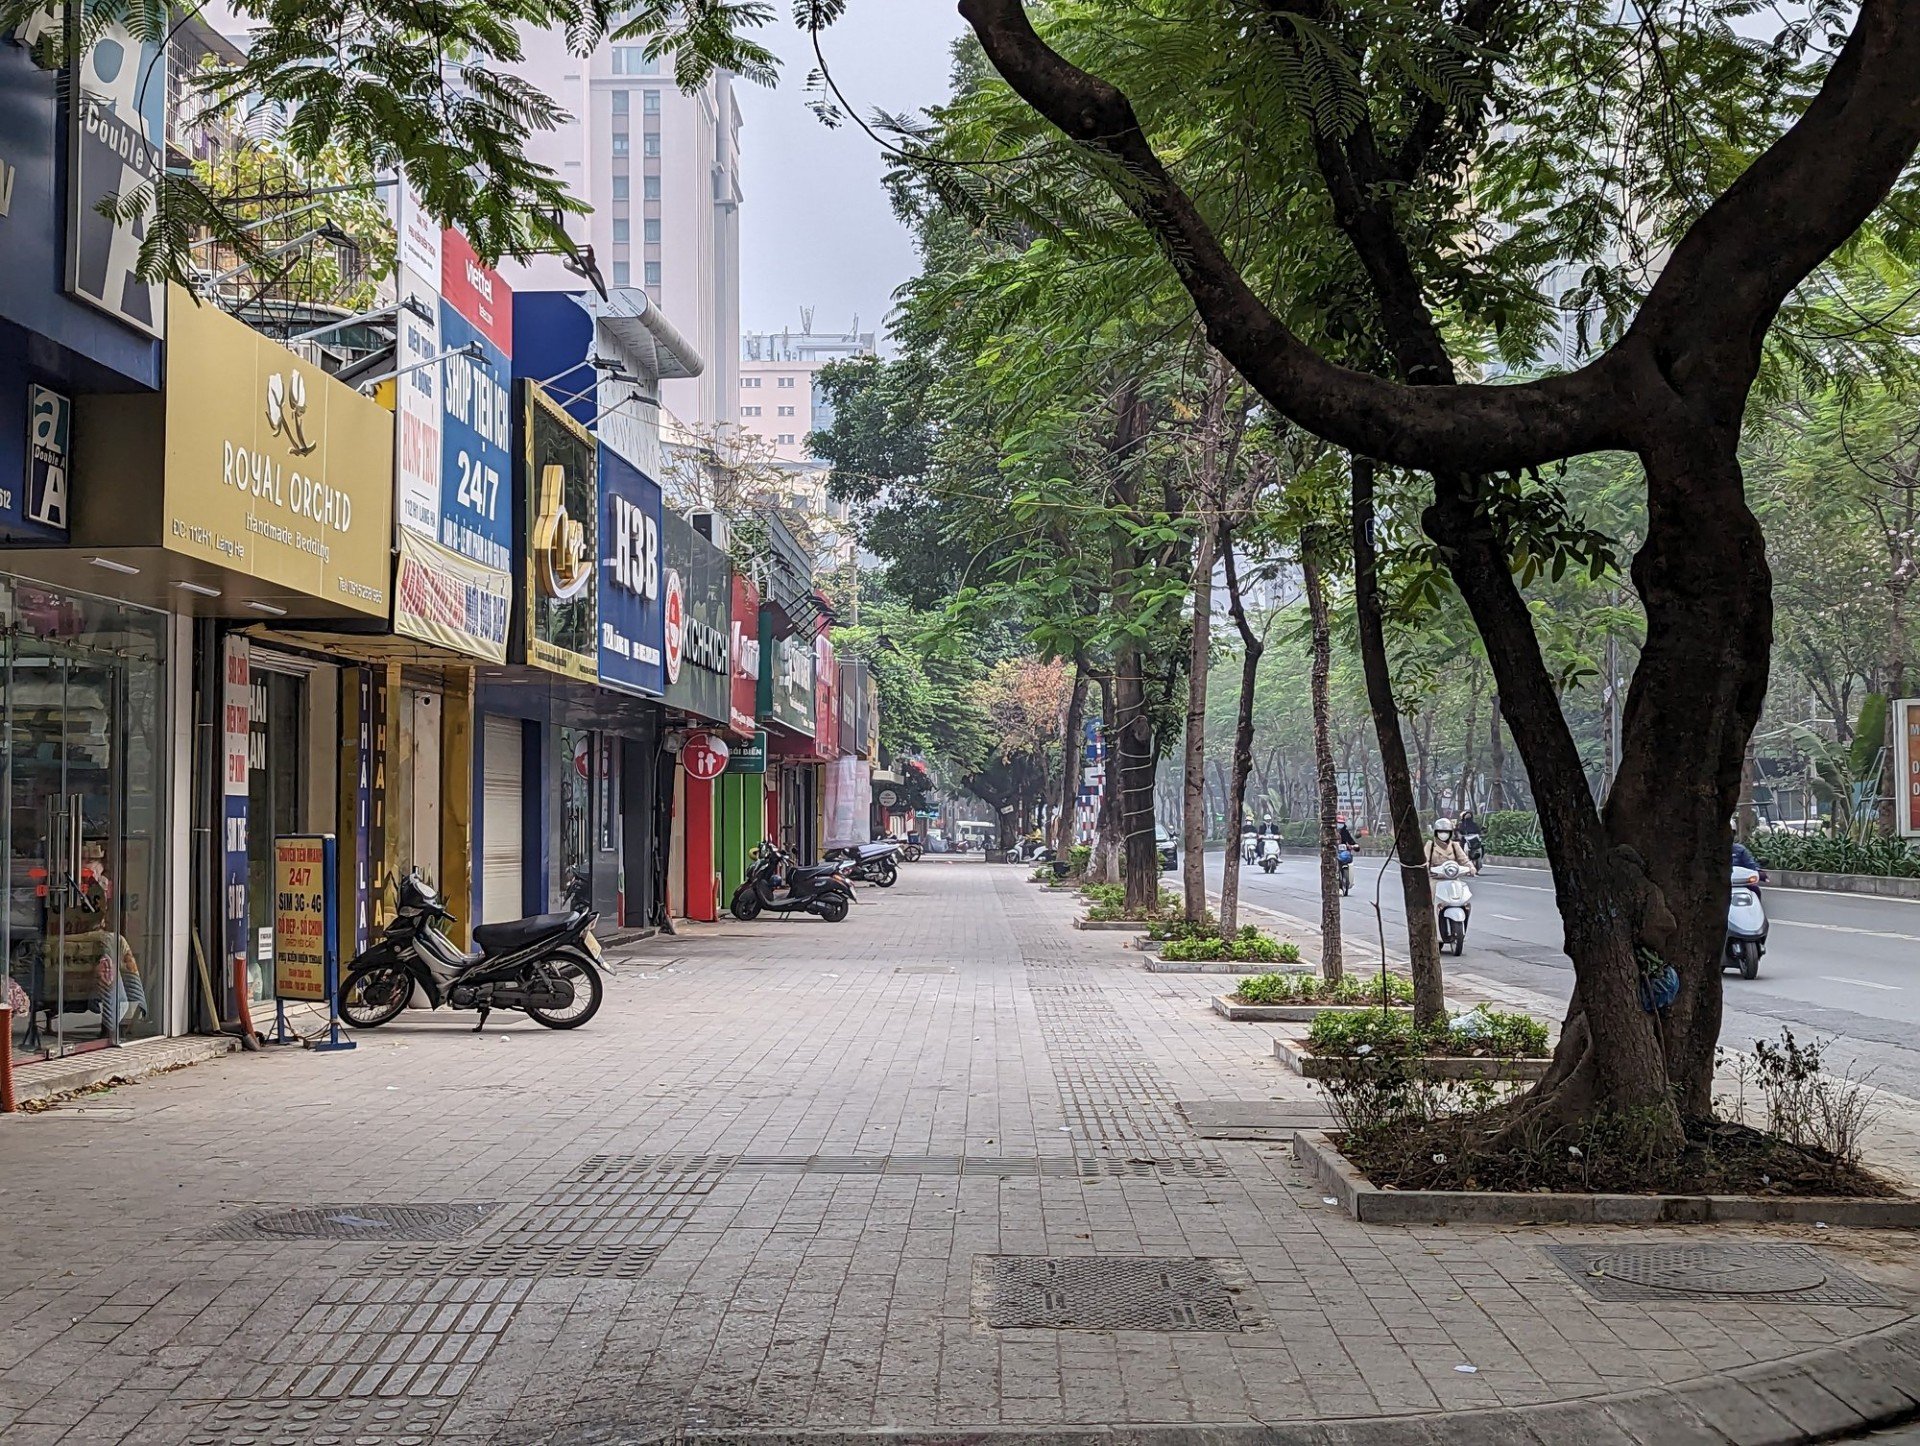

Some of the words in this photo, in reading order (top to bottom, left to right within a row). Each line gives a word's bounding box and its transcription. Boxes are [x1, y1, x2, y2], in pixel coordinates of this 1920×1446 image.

[86, 100, 144, 169] Double
[149, 151, 160, 182] A
[445, 344, 471, 425] SHOP
[473, 363, 493, 452] TIỆN
[494, 370, 509, 454] ÍCH
[34, 447, 58, 465] Double
[60, 457, 65, 469] A
[222, 440, 283, 507] ROYAL
[289, 472, 351, 532] ORCHID
[457, 450, 499, 522] 24/7
[215, 533, 233, 557] Láng
[246, 511, 292, 546] Handmade
[295, 531, 330, 564] Bedding
[613, 494, 658, 600] H3B
[249, 676, 267, 723] HÁI
[360, 683, 368, 827] THÁI
[279, 892, 292, 911] SIM
[295, 893, 304, 911] 3G
[311, 894, 321, 913] 4G
[289, 867, 311, 886] 24/7
